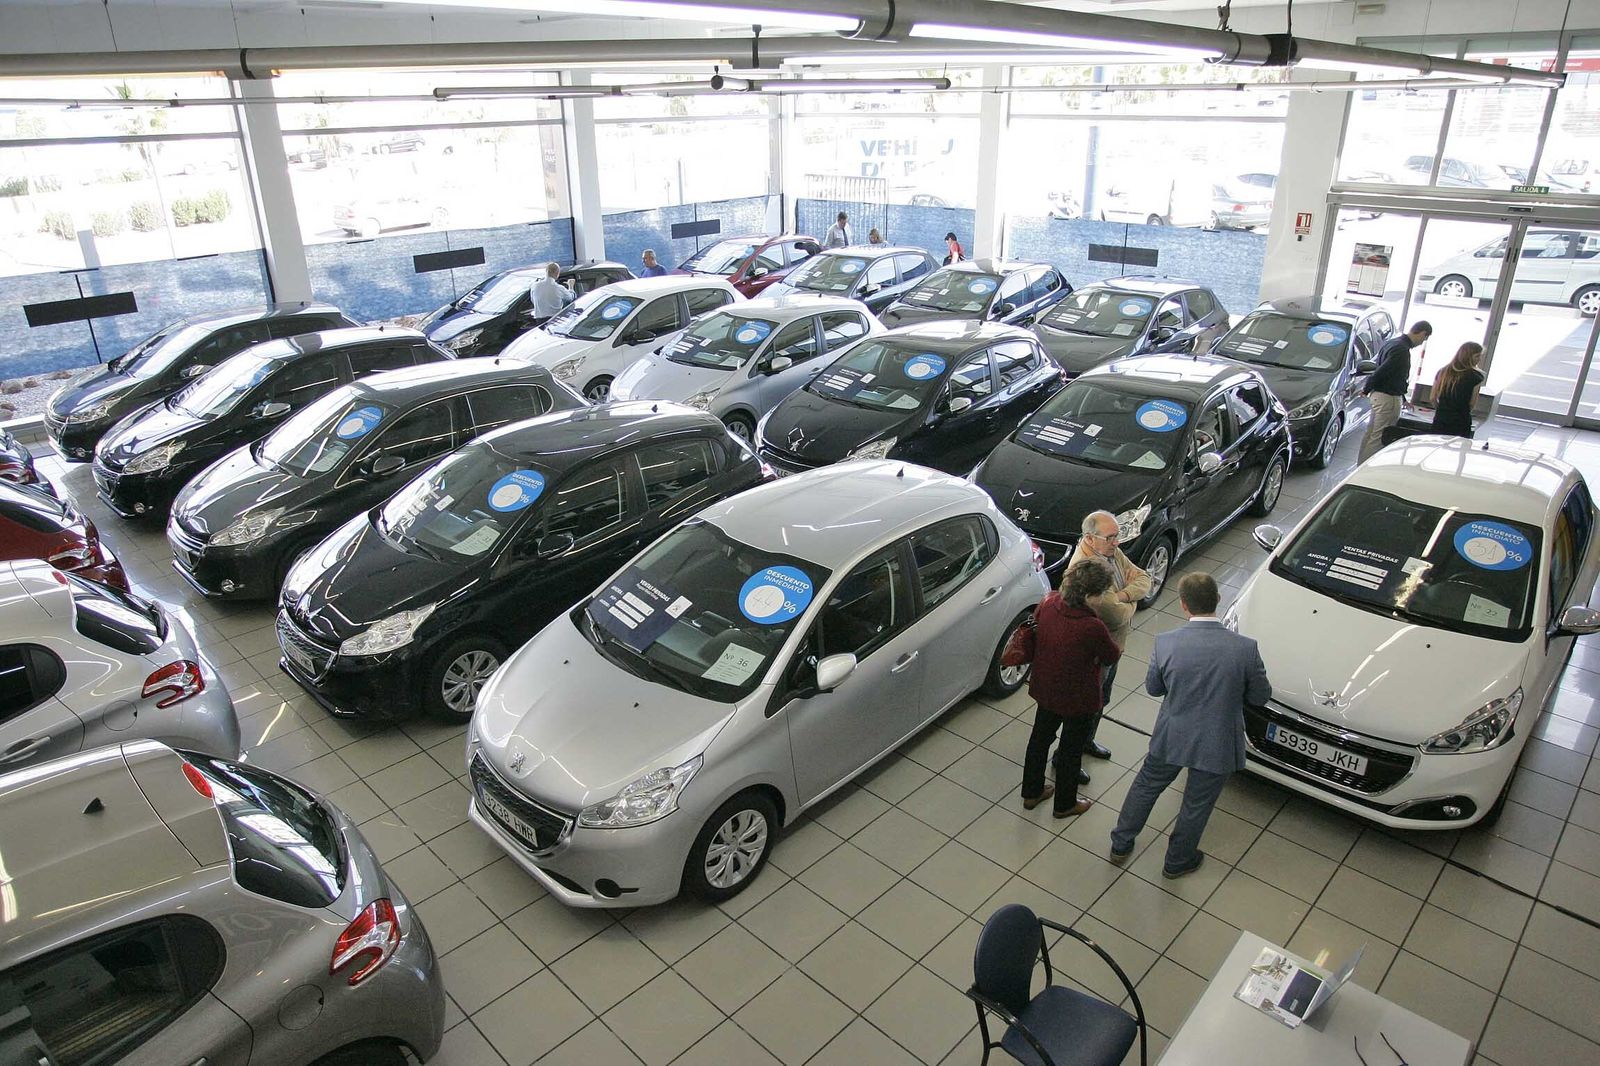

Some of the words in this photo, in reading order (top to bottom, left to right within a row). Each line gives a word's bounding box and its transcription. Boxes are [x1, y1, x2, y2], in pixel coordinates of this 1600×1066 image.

[1514, 185, 1539, 193] SALIDA
[520, 494, 530, 504] %
[1471, 523, 1524, 541] DESCUENTO
[1471, 529, 1521, 545] INMEDIATO
[1343, 545, 1367, 556] VENTAS
[1367, 550, 1399, 564] PRIVADAS
[1506, 550, 1522, 562] %
[763, 575, 804, 594] INMEDIATO
[766, 569, 810, 590] DESCUENTO
[783, 600, 797, 614] %
[737, 658, 750, 668] 36
[1279, 729, 1318, 756] 5939
[1326, 750, 1360, 771] JKH
